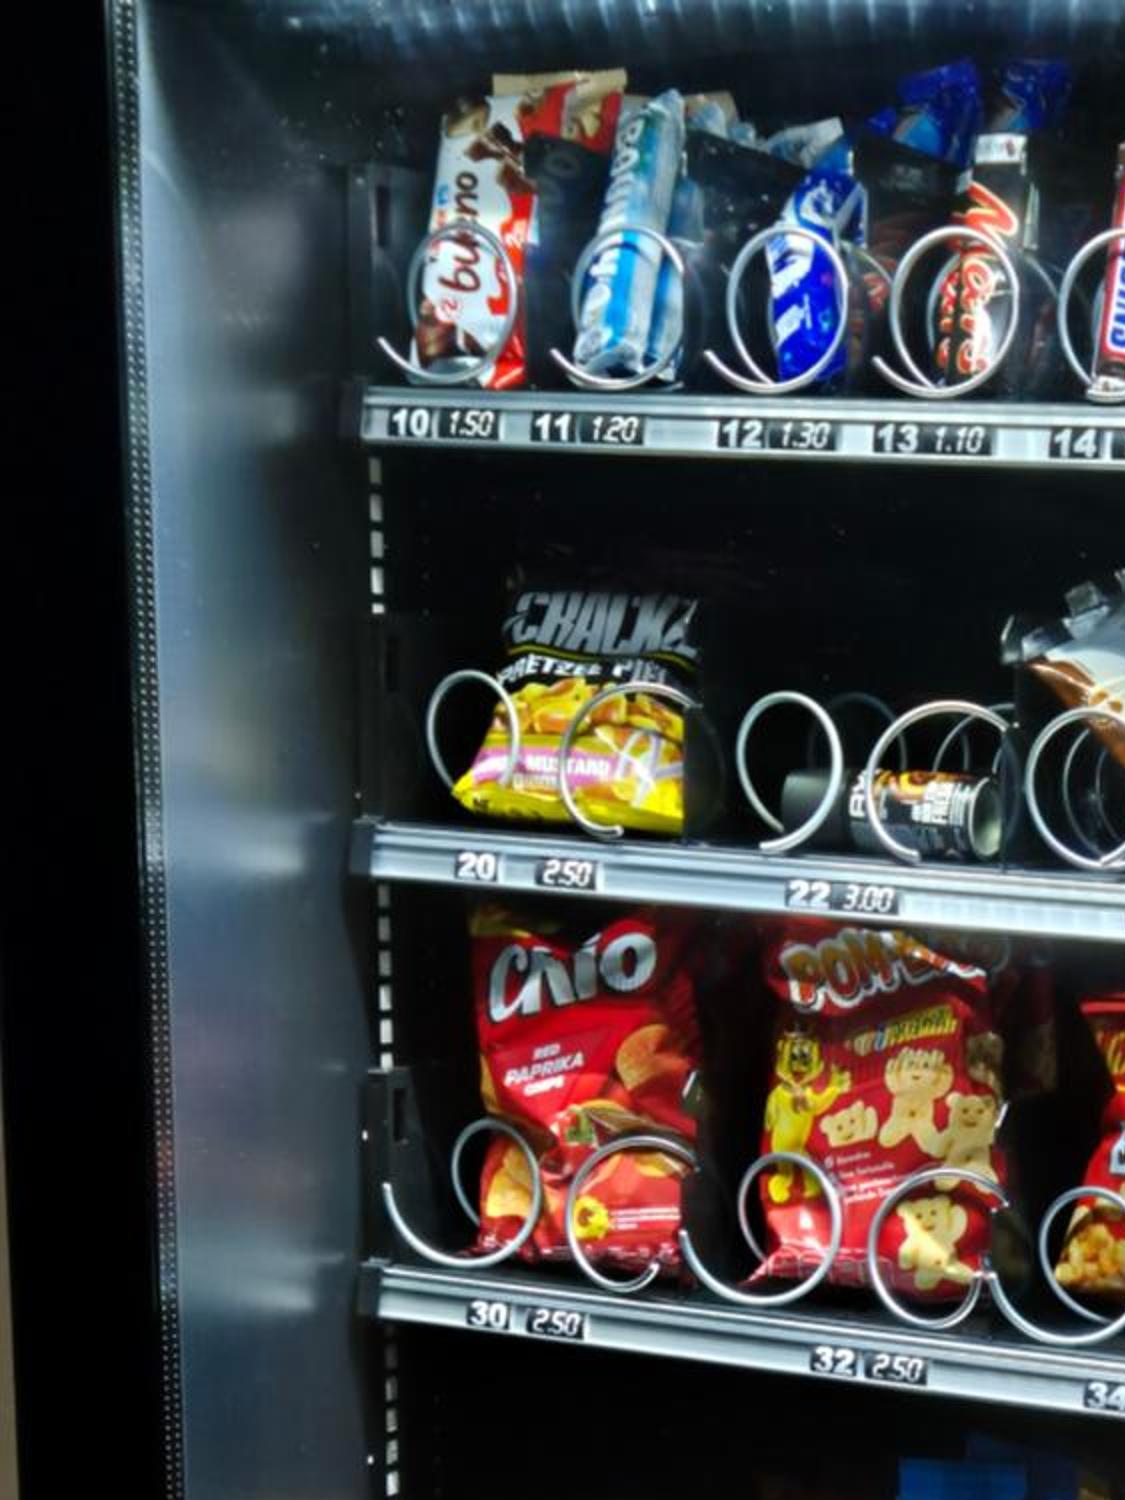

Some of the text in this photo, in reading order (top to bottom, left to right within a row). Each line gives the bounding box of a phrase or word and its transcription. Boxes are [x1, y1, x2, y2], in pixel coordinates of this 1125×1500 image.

[392, 408, 494, 437] 10 1.50
[534, 412, 640, 443] 11 1.20
[723, 419, 831, 449] 12 1.30
[877, 424, 985, 454] 13 1.10
[1054, 428, 1098, 457] 14
[456, 852, 594, 888] 20 2.50
[789, 880, 896, 913] 22 3.00
[504, 1051, 584, 1086] PAPRIKA
[470, 1301, 504, 1327] 30
[814, 1347, 854, 1374] 32
